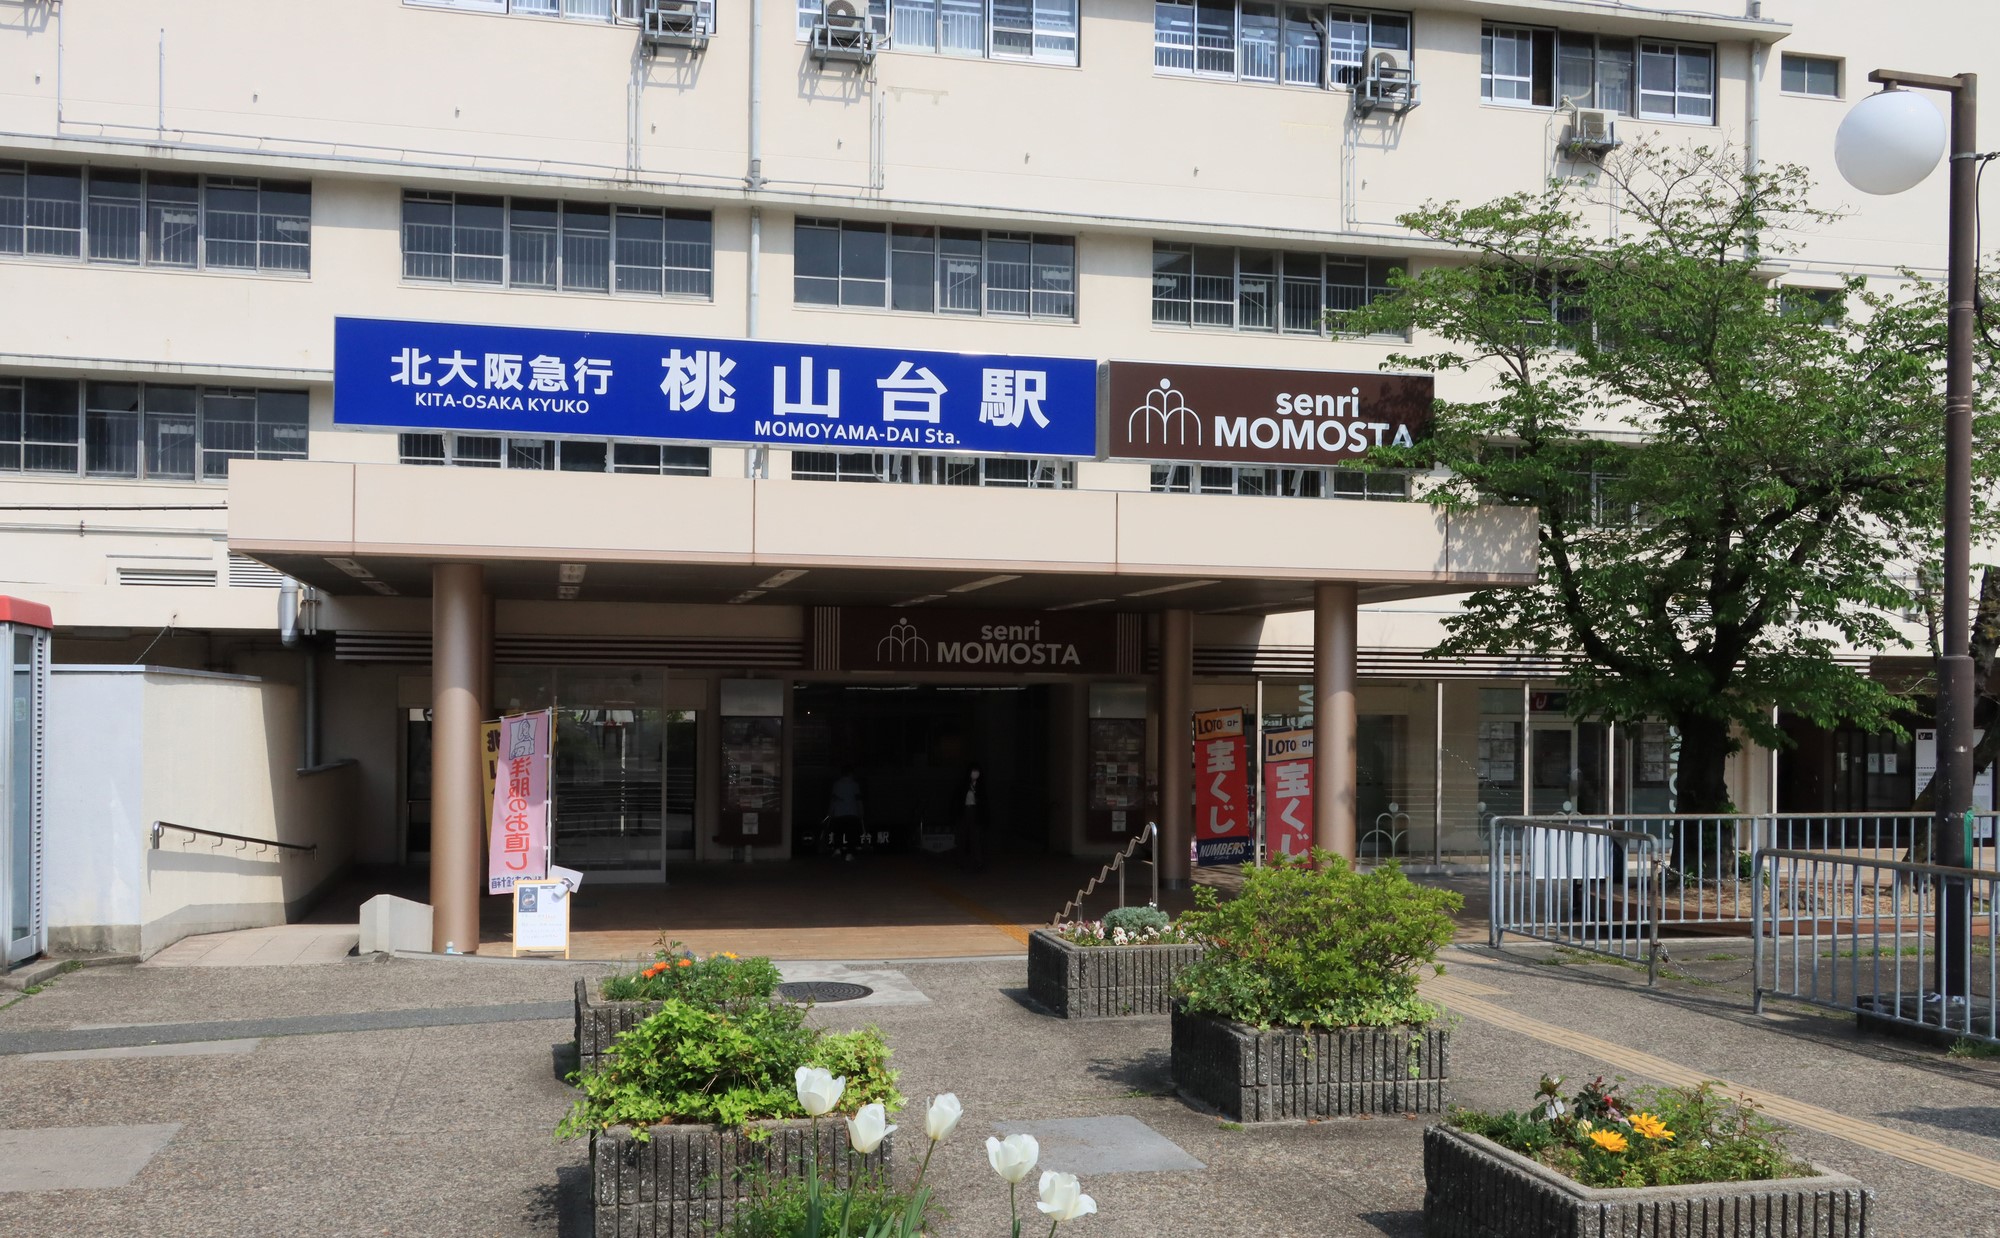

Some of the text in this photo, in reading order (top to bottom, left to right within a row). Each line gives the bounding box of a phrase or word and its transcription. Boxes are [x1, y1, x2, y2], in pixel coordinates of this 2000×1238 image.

[390, 347, 614, 396] 北大阪急行
[659, 347, 1051, 430] 桃山台駅
[415, 392, 590, 415] KITA-OSAKA KYUKO
[1275, 386, 1360, 418] senri
[754, 420, 961, 445] MOMOYAMA-DAI Sta.
[1213, 415, 1414, 453] MOMOSTA
[980, 619, 1041, 641] senri
[936, 641, 1081, 665] MOMOSTA
[1198, 718, 1223, 735] LOTO
[1267, 738, 1297, 757] LOTO
[1206, 739, 1236, 835] 宝くじ
[1275, 762, 1311, 864] 宝くじ
[1199, 841, 1246, 858] NUMBERS
